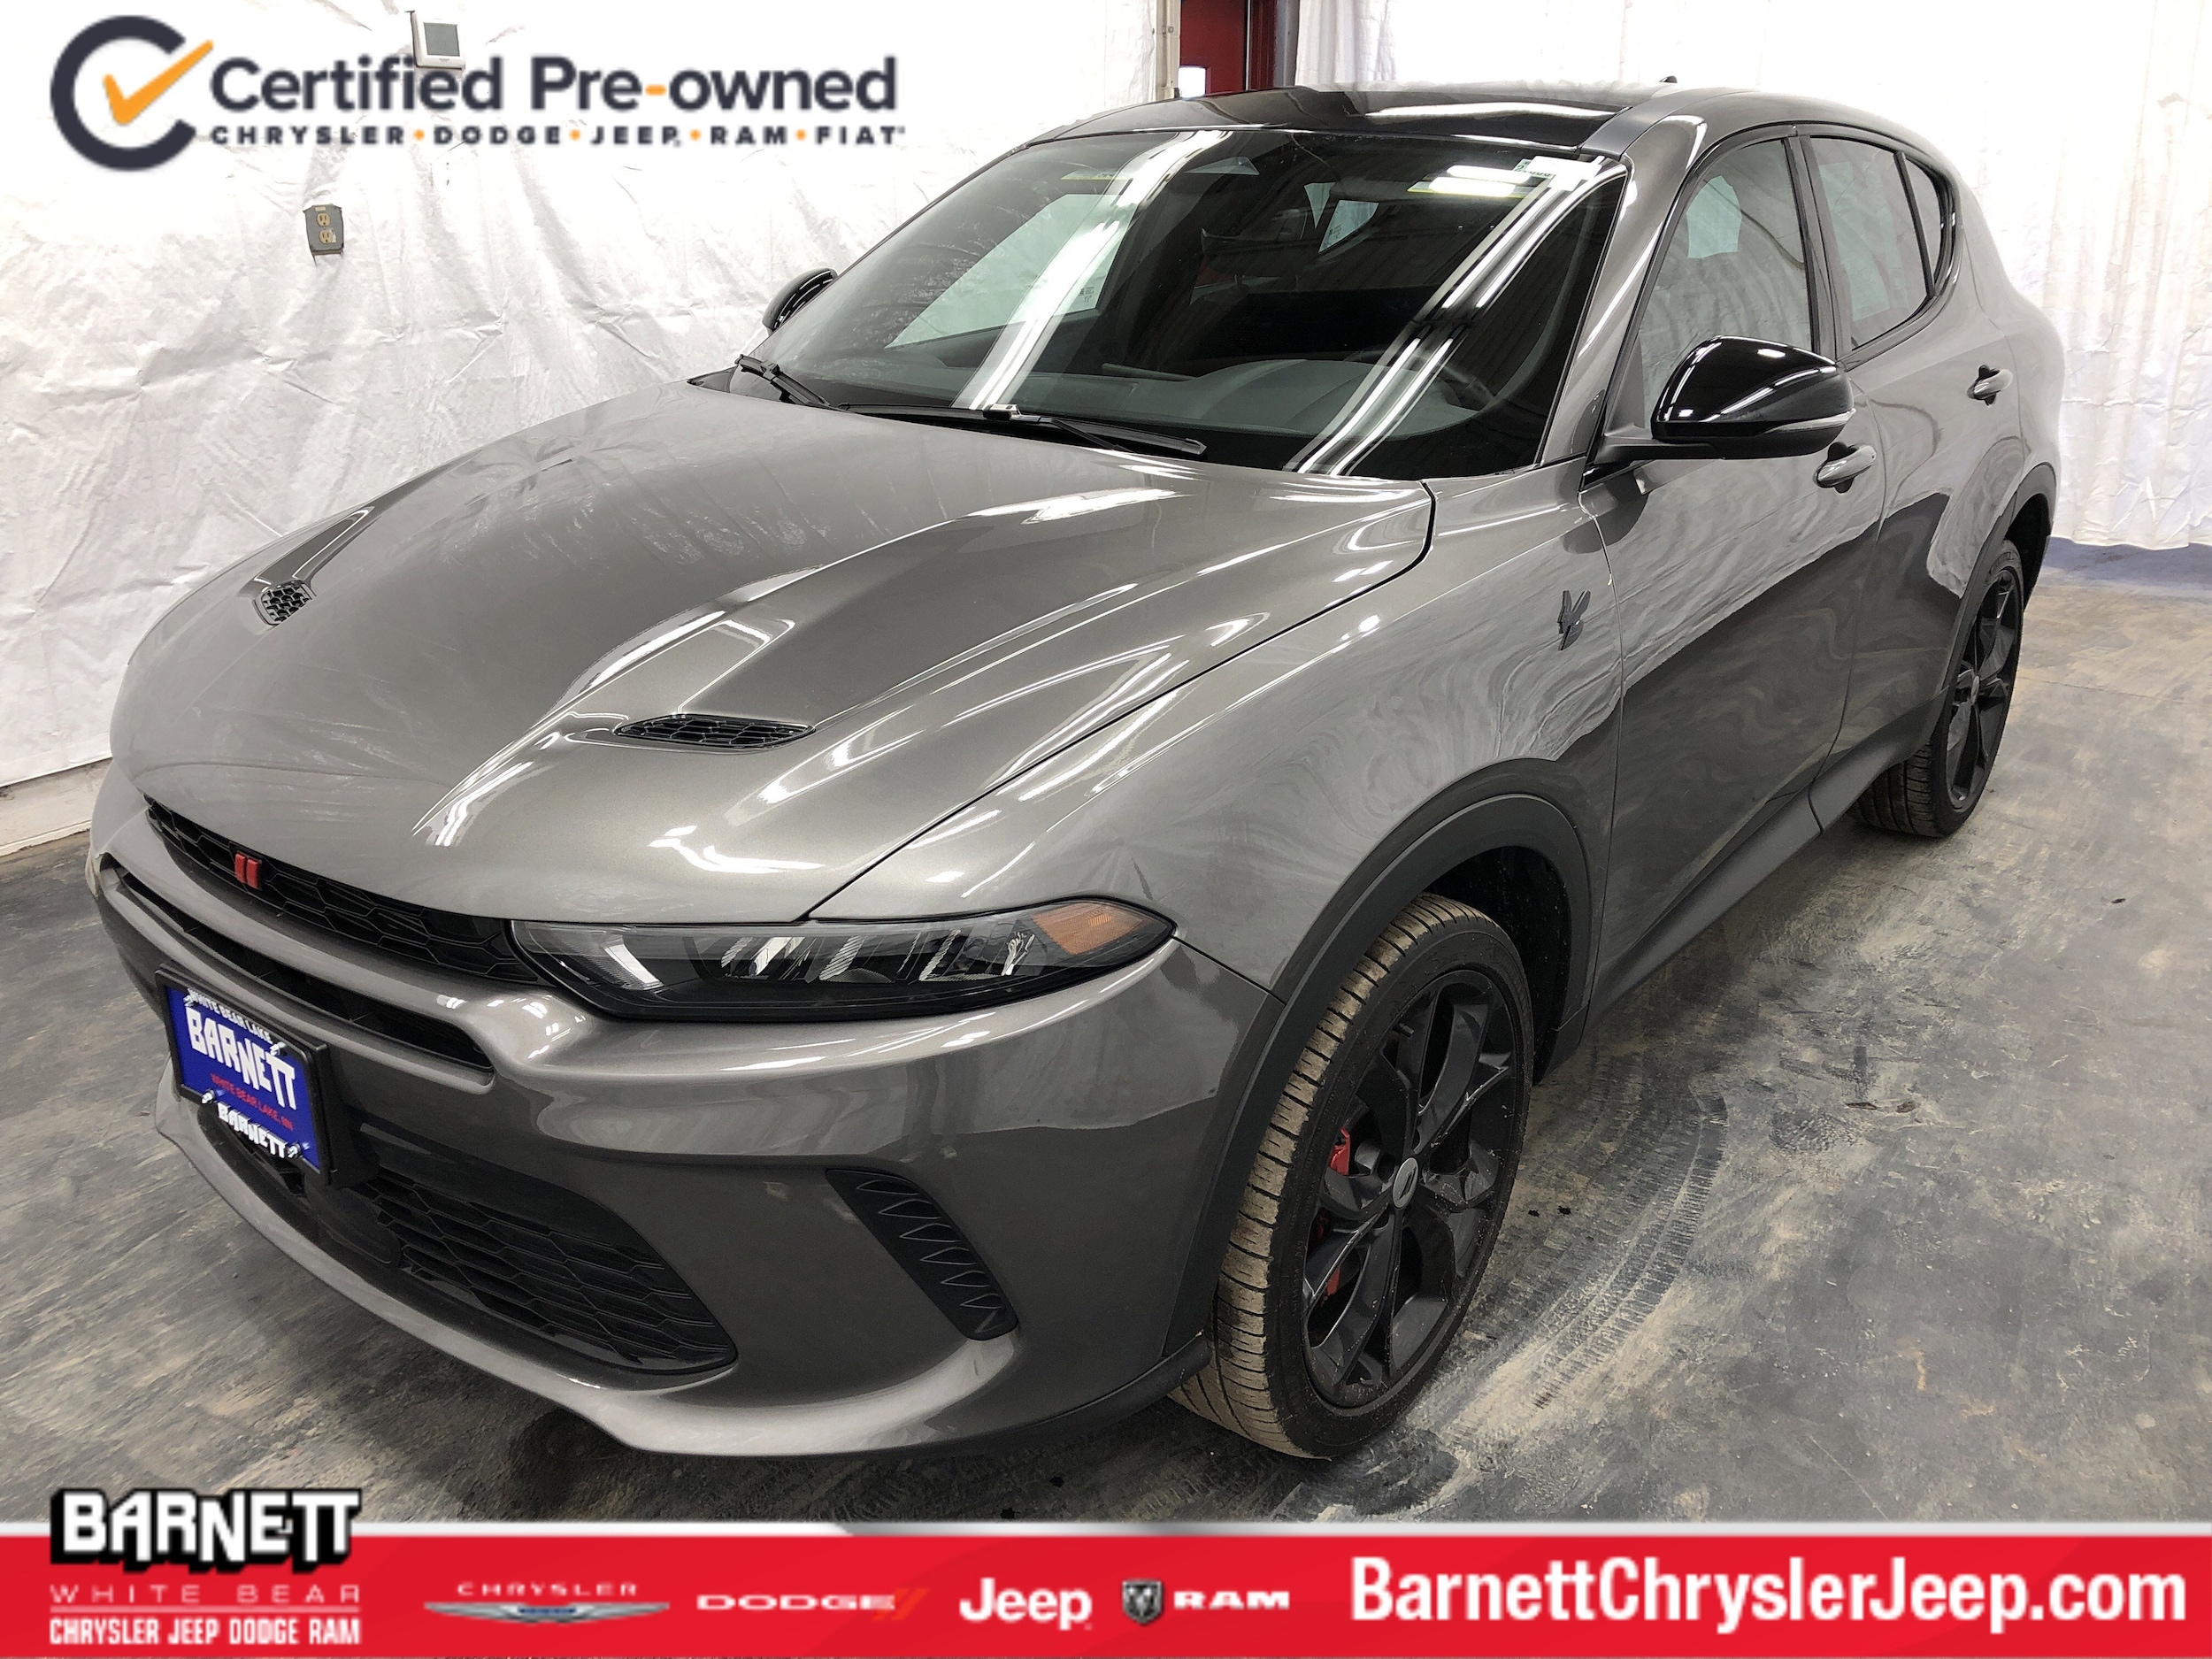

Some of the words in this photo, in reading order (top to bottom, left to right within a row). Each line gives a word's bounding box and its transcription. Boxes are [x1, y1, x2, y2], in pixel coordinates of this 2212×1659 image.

[188, 988, 220, 1015] WHITE
[219, 1005, 247, 1029] BEAR
[245, 1019, 273, 1044] LAKE
[186, 1006, 297, 1110] BARNETT
[217, 1101, 288, 1159] BARNETT
